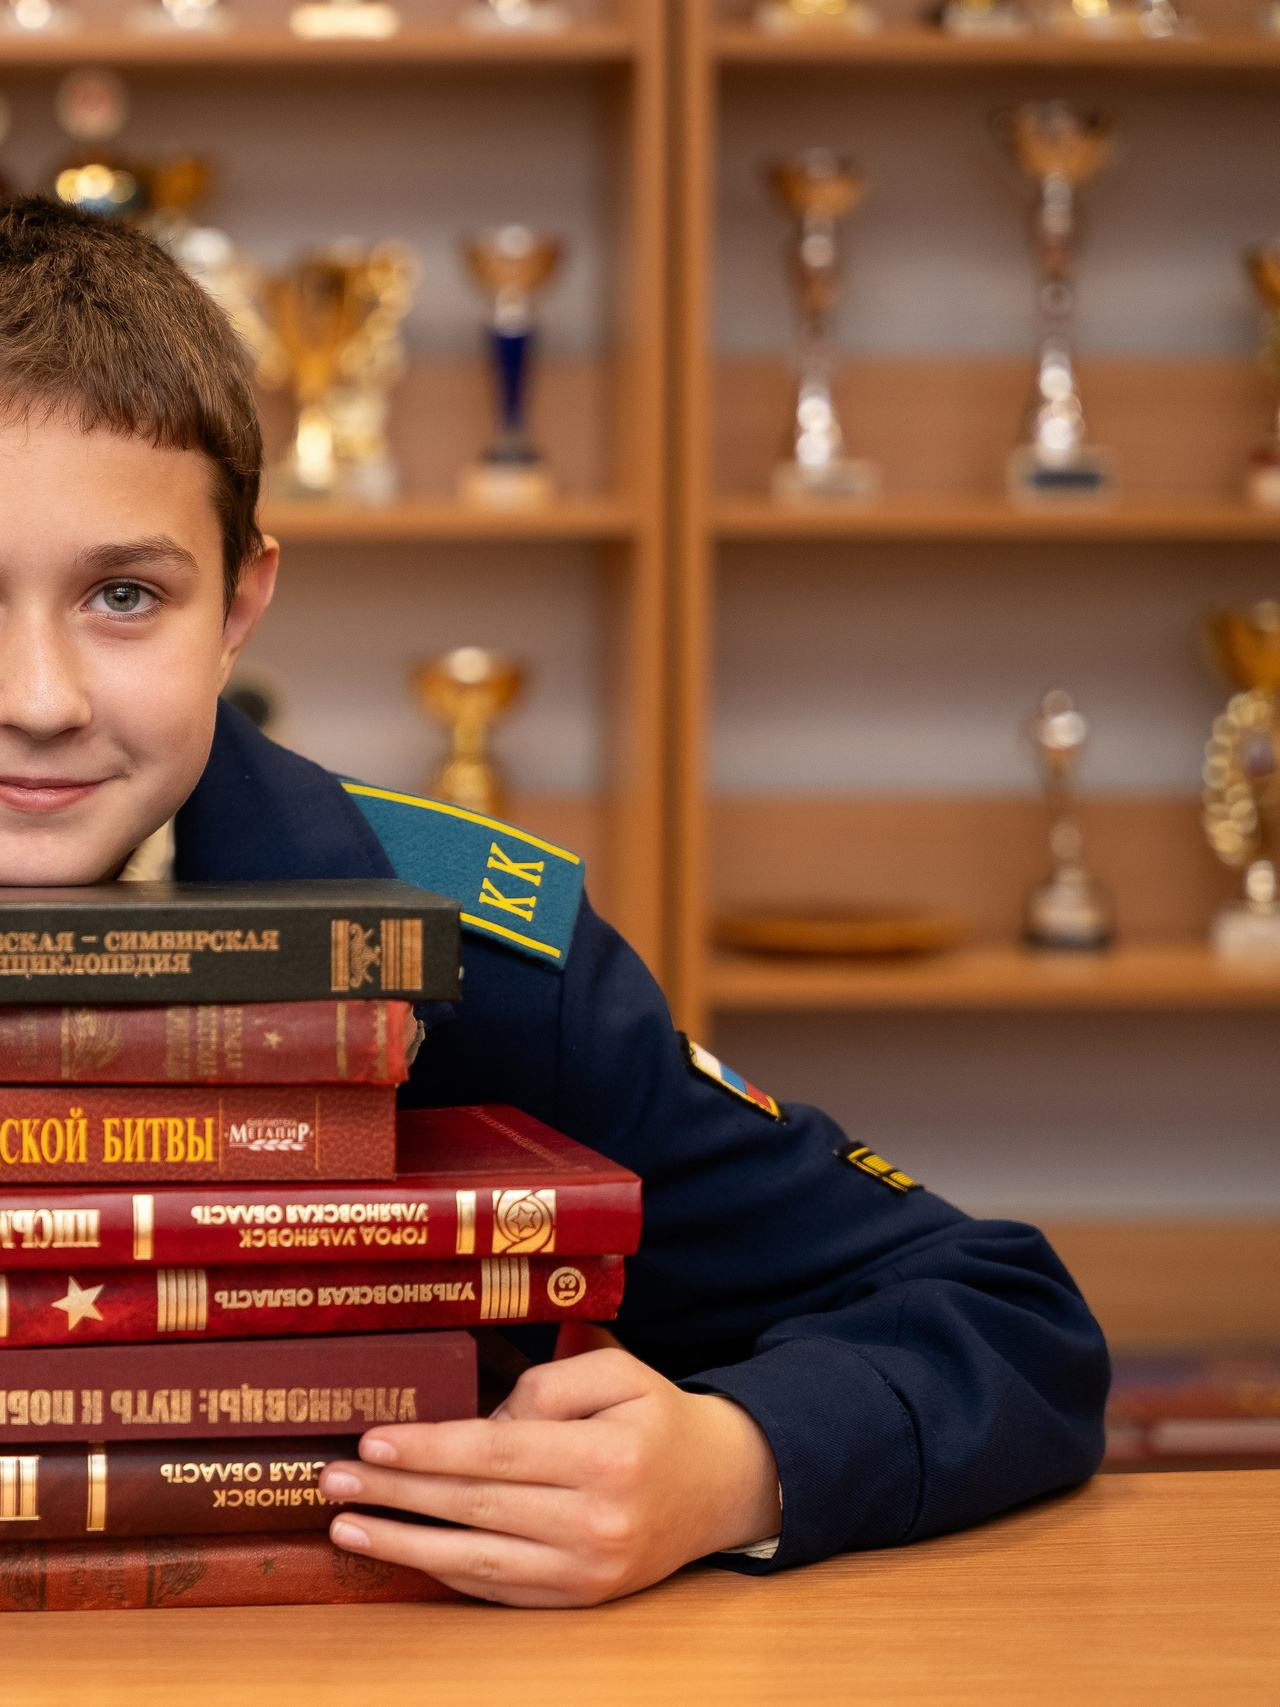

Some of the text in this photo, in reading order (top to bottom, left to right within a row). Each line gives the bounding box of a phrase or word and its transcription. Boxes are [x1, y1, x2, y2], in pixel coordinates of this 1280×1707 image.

[104, 929, 279, 952] СИМБИРСКАЯ
[102, 1116, 215, 1165] БИТВЫ
[191, 1203, 429, 1225] УЛЬЯНОВСКАЯ ОБЛАСТЬ
[239, 1226, 429, 1248] ГОРОД УЛЬЯНОВСК
[214, 1281, 476, 1309] УЛЬЯНОВСКАЯ ОБЛАСТЬ
[80, 1389, 103, 1425] К
[111, 1388, 192, 1425] ПУТЬ
[199, 1383, 417, 1424] УЛЬЯНОВЦЫ:
[160, 1462, 263, 1483] ОБЛАСТЬ
